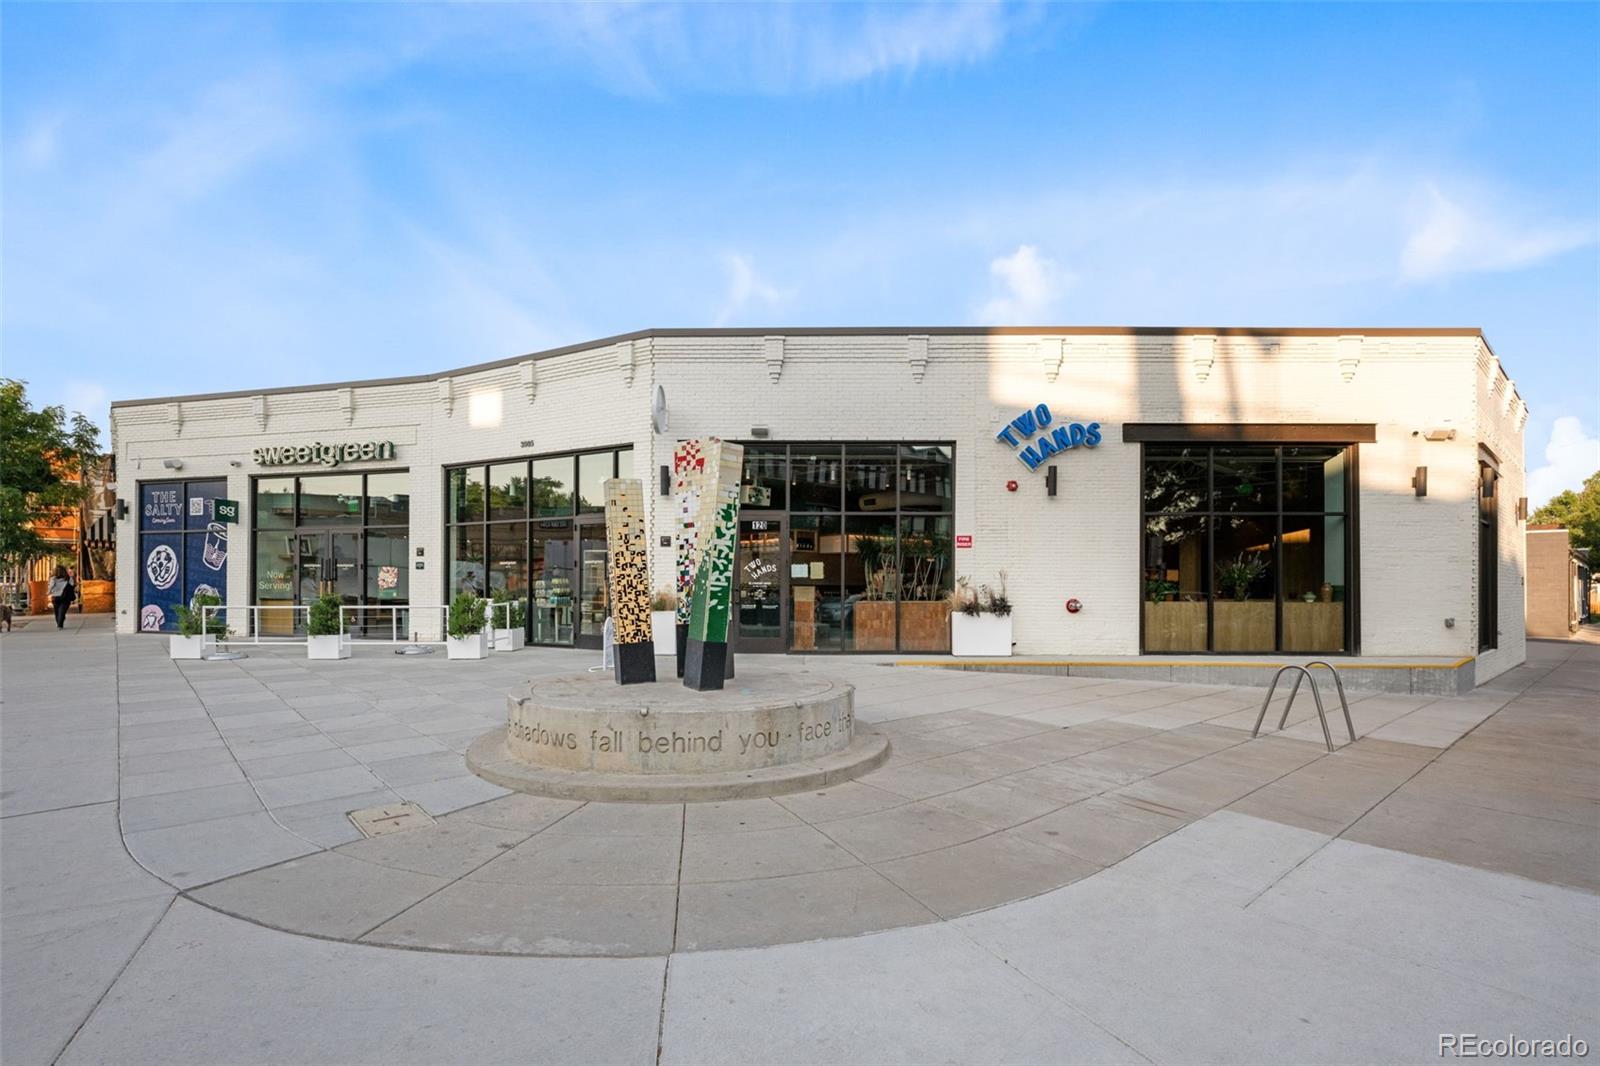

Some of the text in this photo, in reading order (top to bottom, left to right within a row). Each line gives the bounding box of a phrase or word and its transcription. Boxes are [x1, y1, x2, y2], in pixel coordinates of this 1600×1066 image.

[994, 402, 1053, 449] TWO
[252, 440, 395, 467] sweetgreen
[1017, 421, 1103, 473] HANDS
[152, 491, 176, 503] THE
[145, 503, 182, 516] SALTY
[219, 505, 235, 517] sg
[744, 558, 761, 572] TWO
[751, 564, 777, 580] HANDS
[266, 570, 284, 579] Now
[259, 581, 292, 592] Serving!
[514, 719, 577, 750] shadows
[590, 730, 622, 752] fall
[638, 730, 722, 753] behind
[738, 731, 779, 755] you
[799, 720, 832, 742] face
